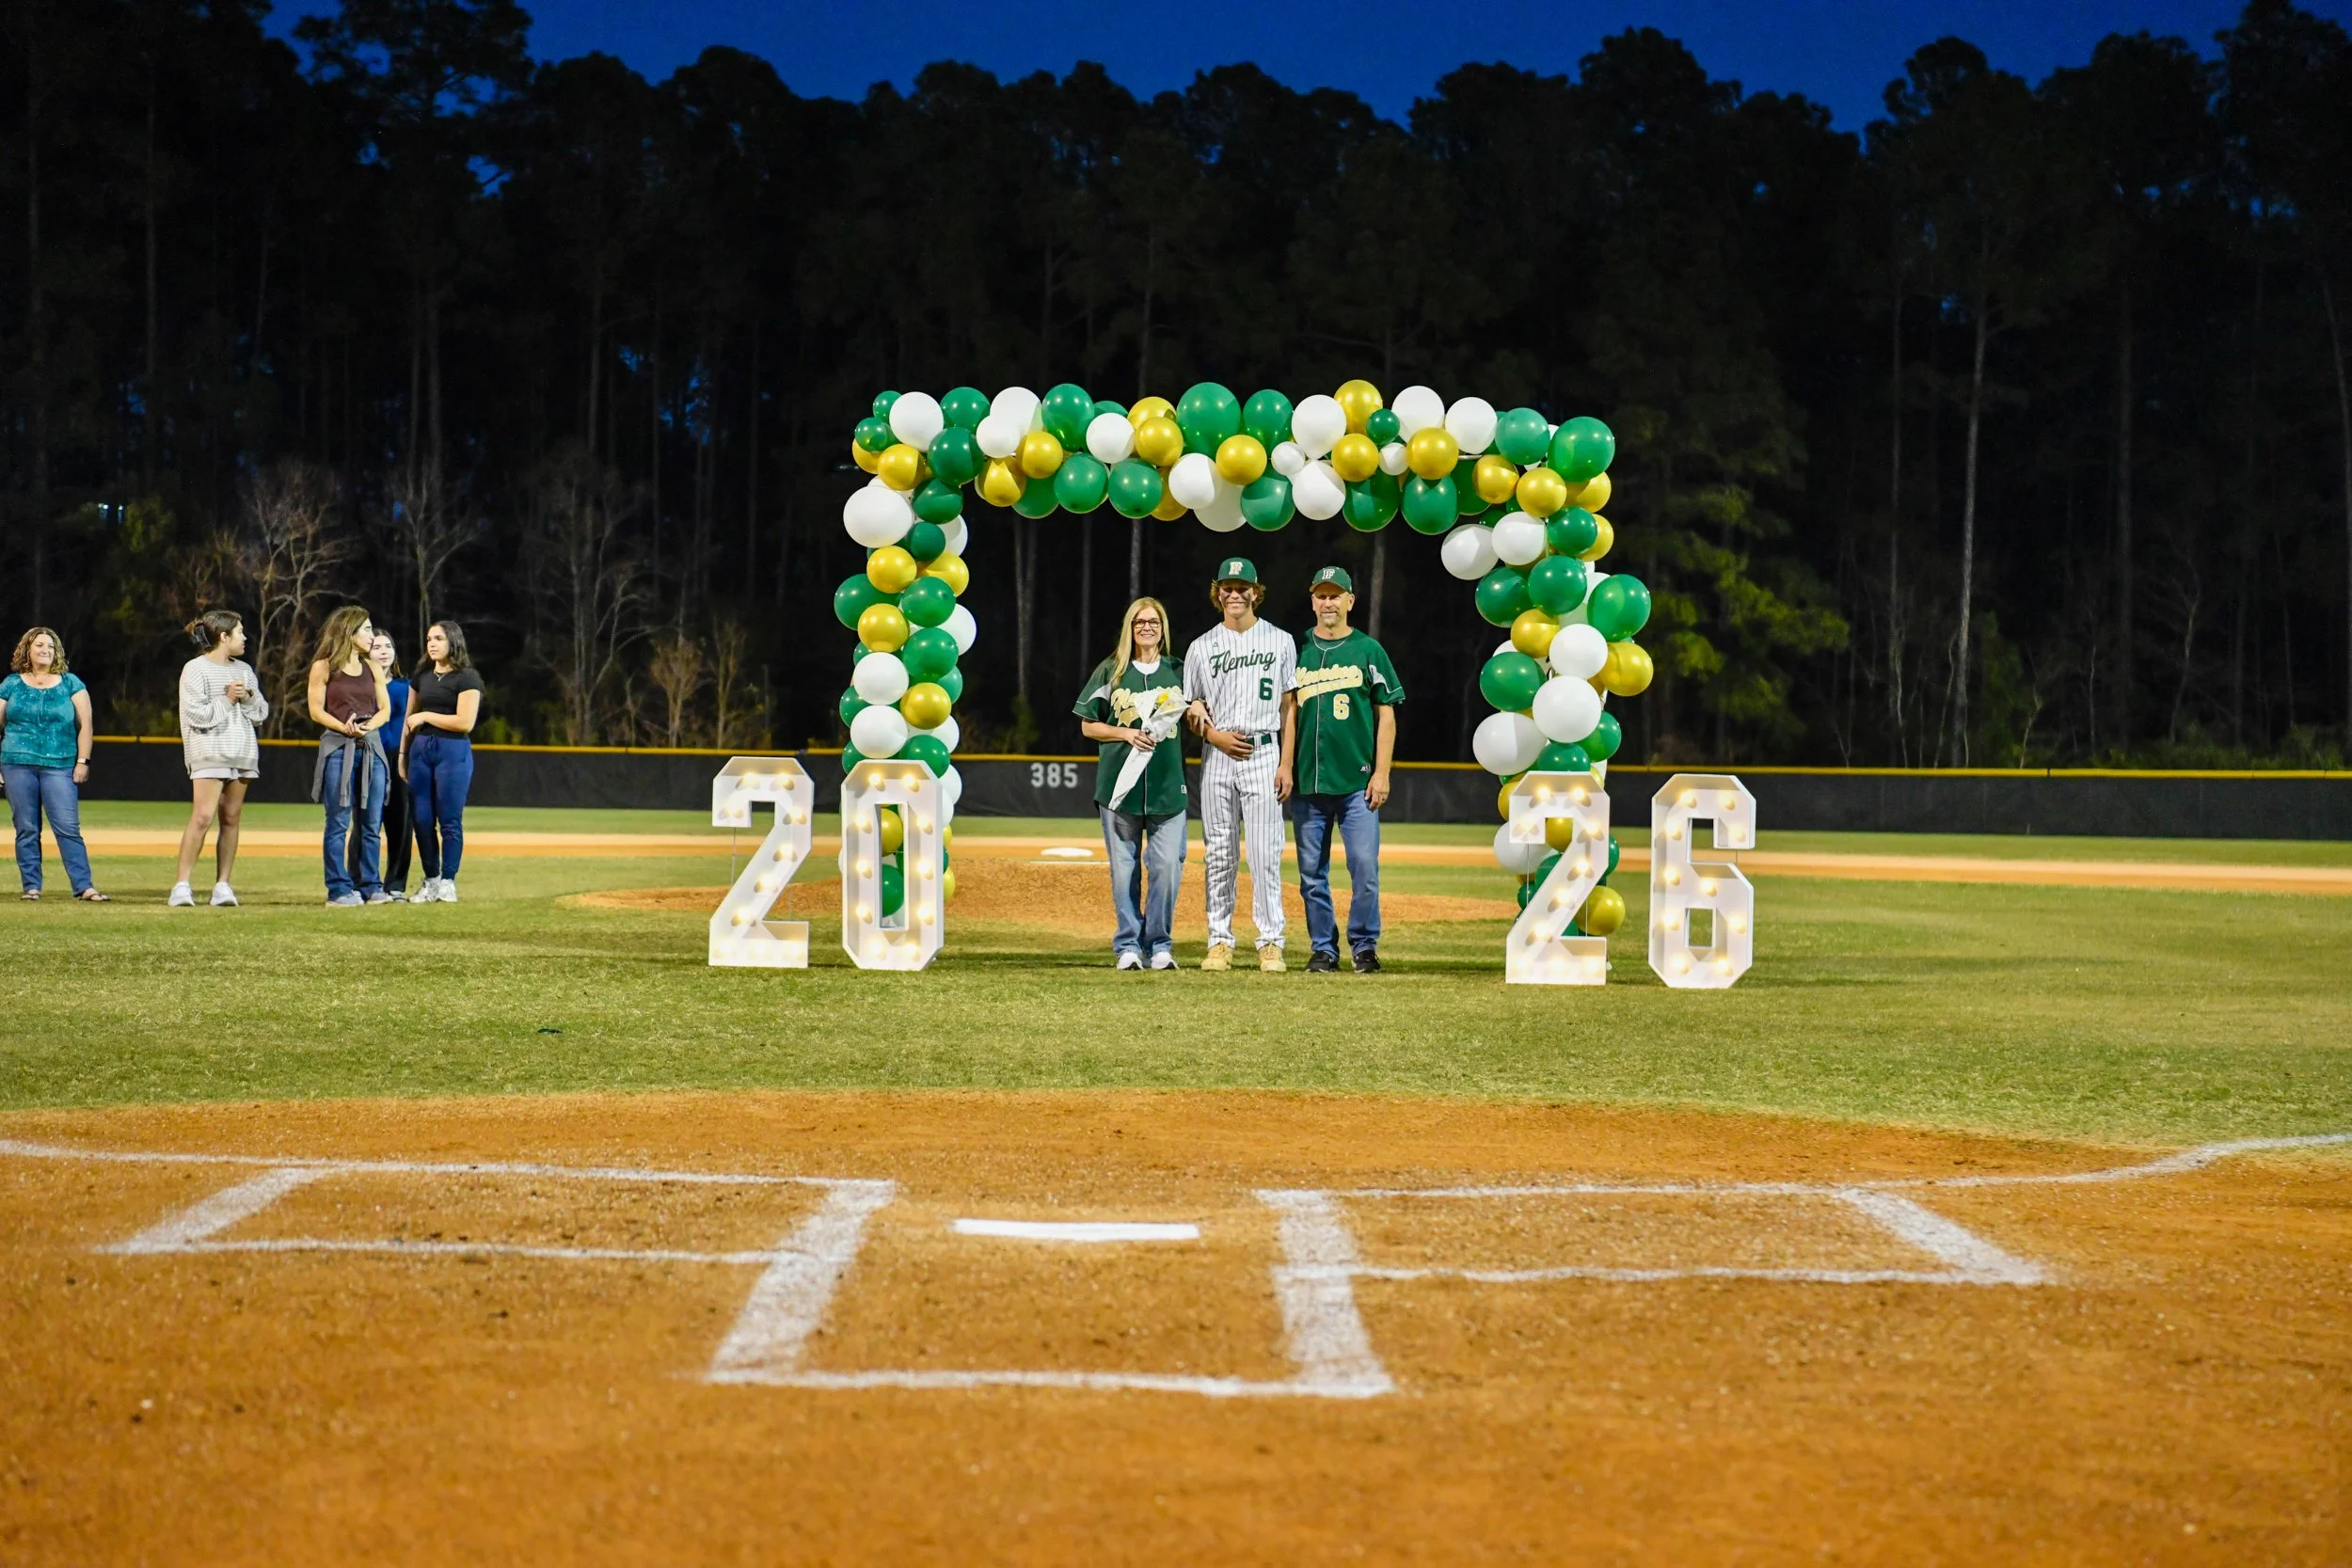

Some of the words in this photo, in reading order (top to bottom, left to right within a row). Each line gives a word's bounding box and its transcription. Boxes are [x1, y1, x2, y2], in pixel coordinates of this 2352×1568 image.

[1209, 649, 1276, 678] Fleming
[1259, 677, 1273, 701] 6
[1333, 693, 1350, 721] 6
[1030, 762, 1078, 788] 385
